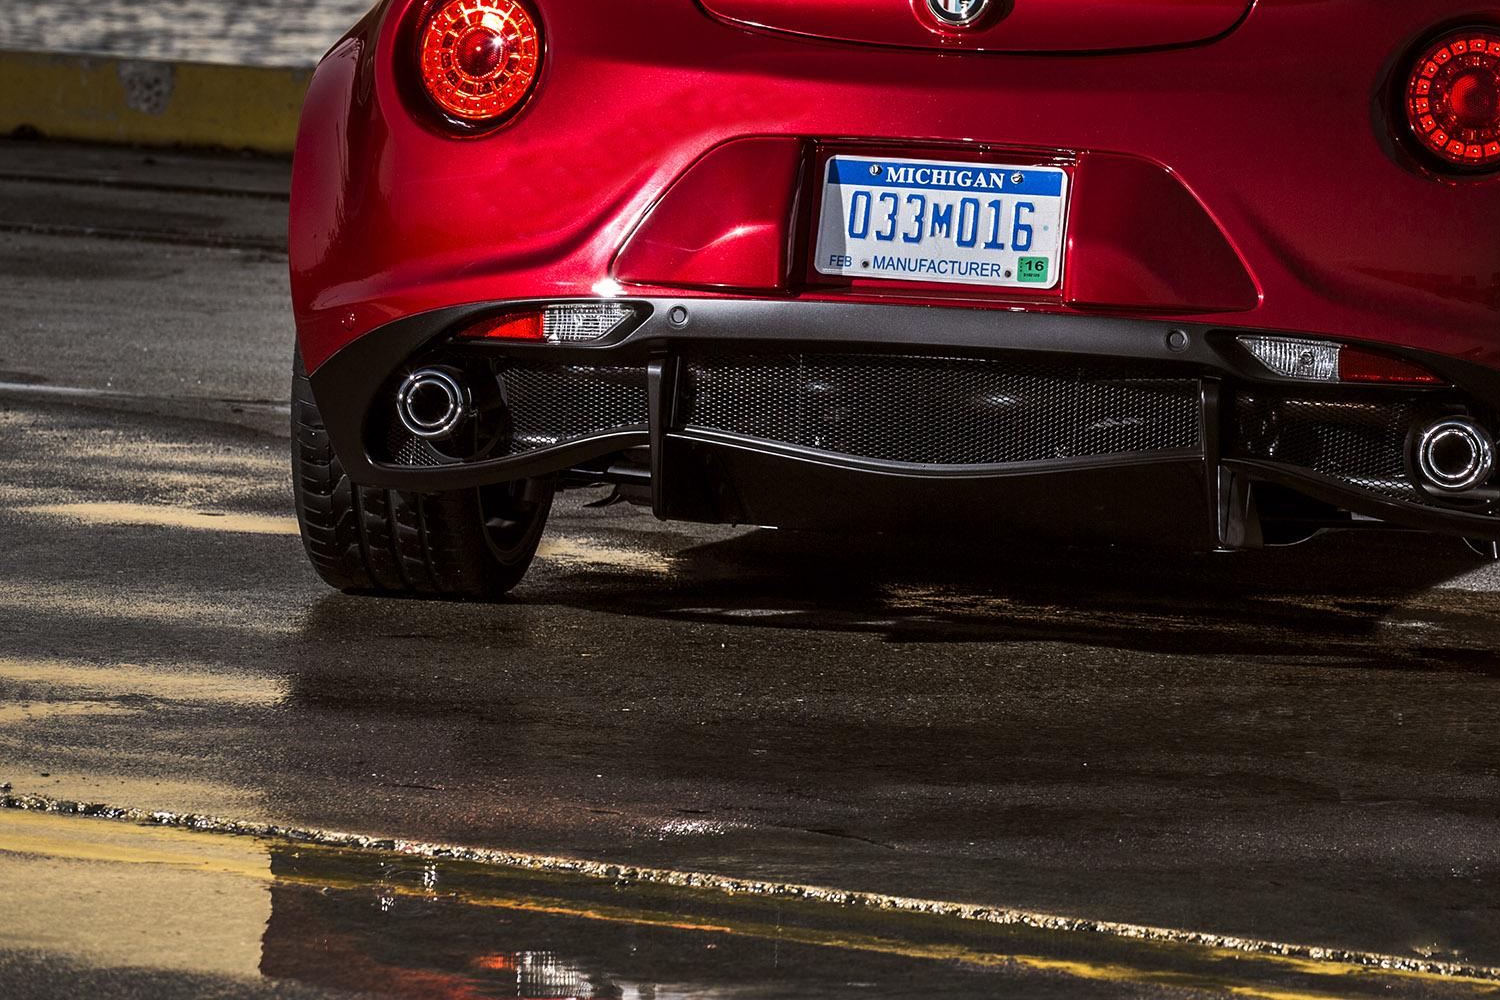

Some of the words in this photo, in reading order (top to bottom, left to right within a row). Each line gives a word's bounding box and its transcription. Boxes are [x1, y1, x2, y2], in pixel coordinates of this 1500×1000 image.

[885, 166, 1006, 189] MICHIGAN
[848, 190, 1035, 252] 033M016
[829, 254, 853, 267] FEB
[872, 255, 1001, 278] MANUFACTURER
[1025, 260, 1044, 271] 16
